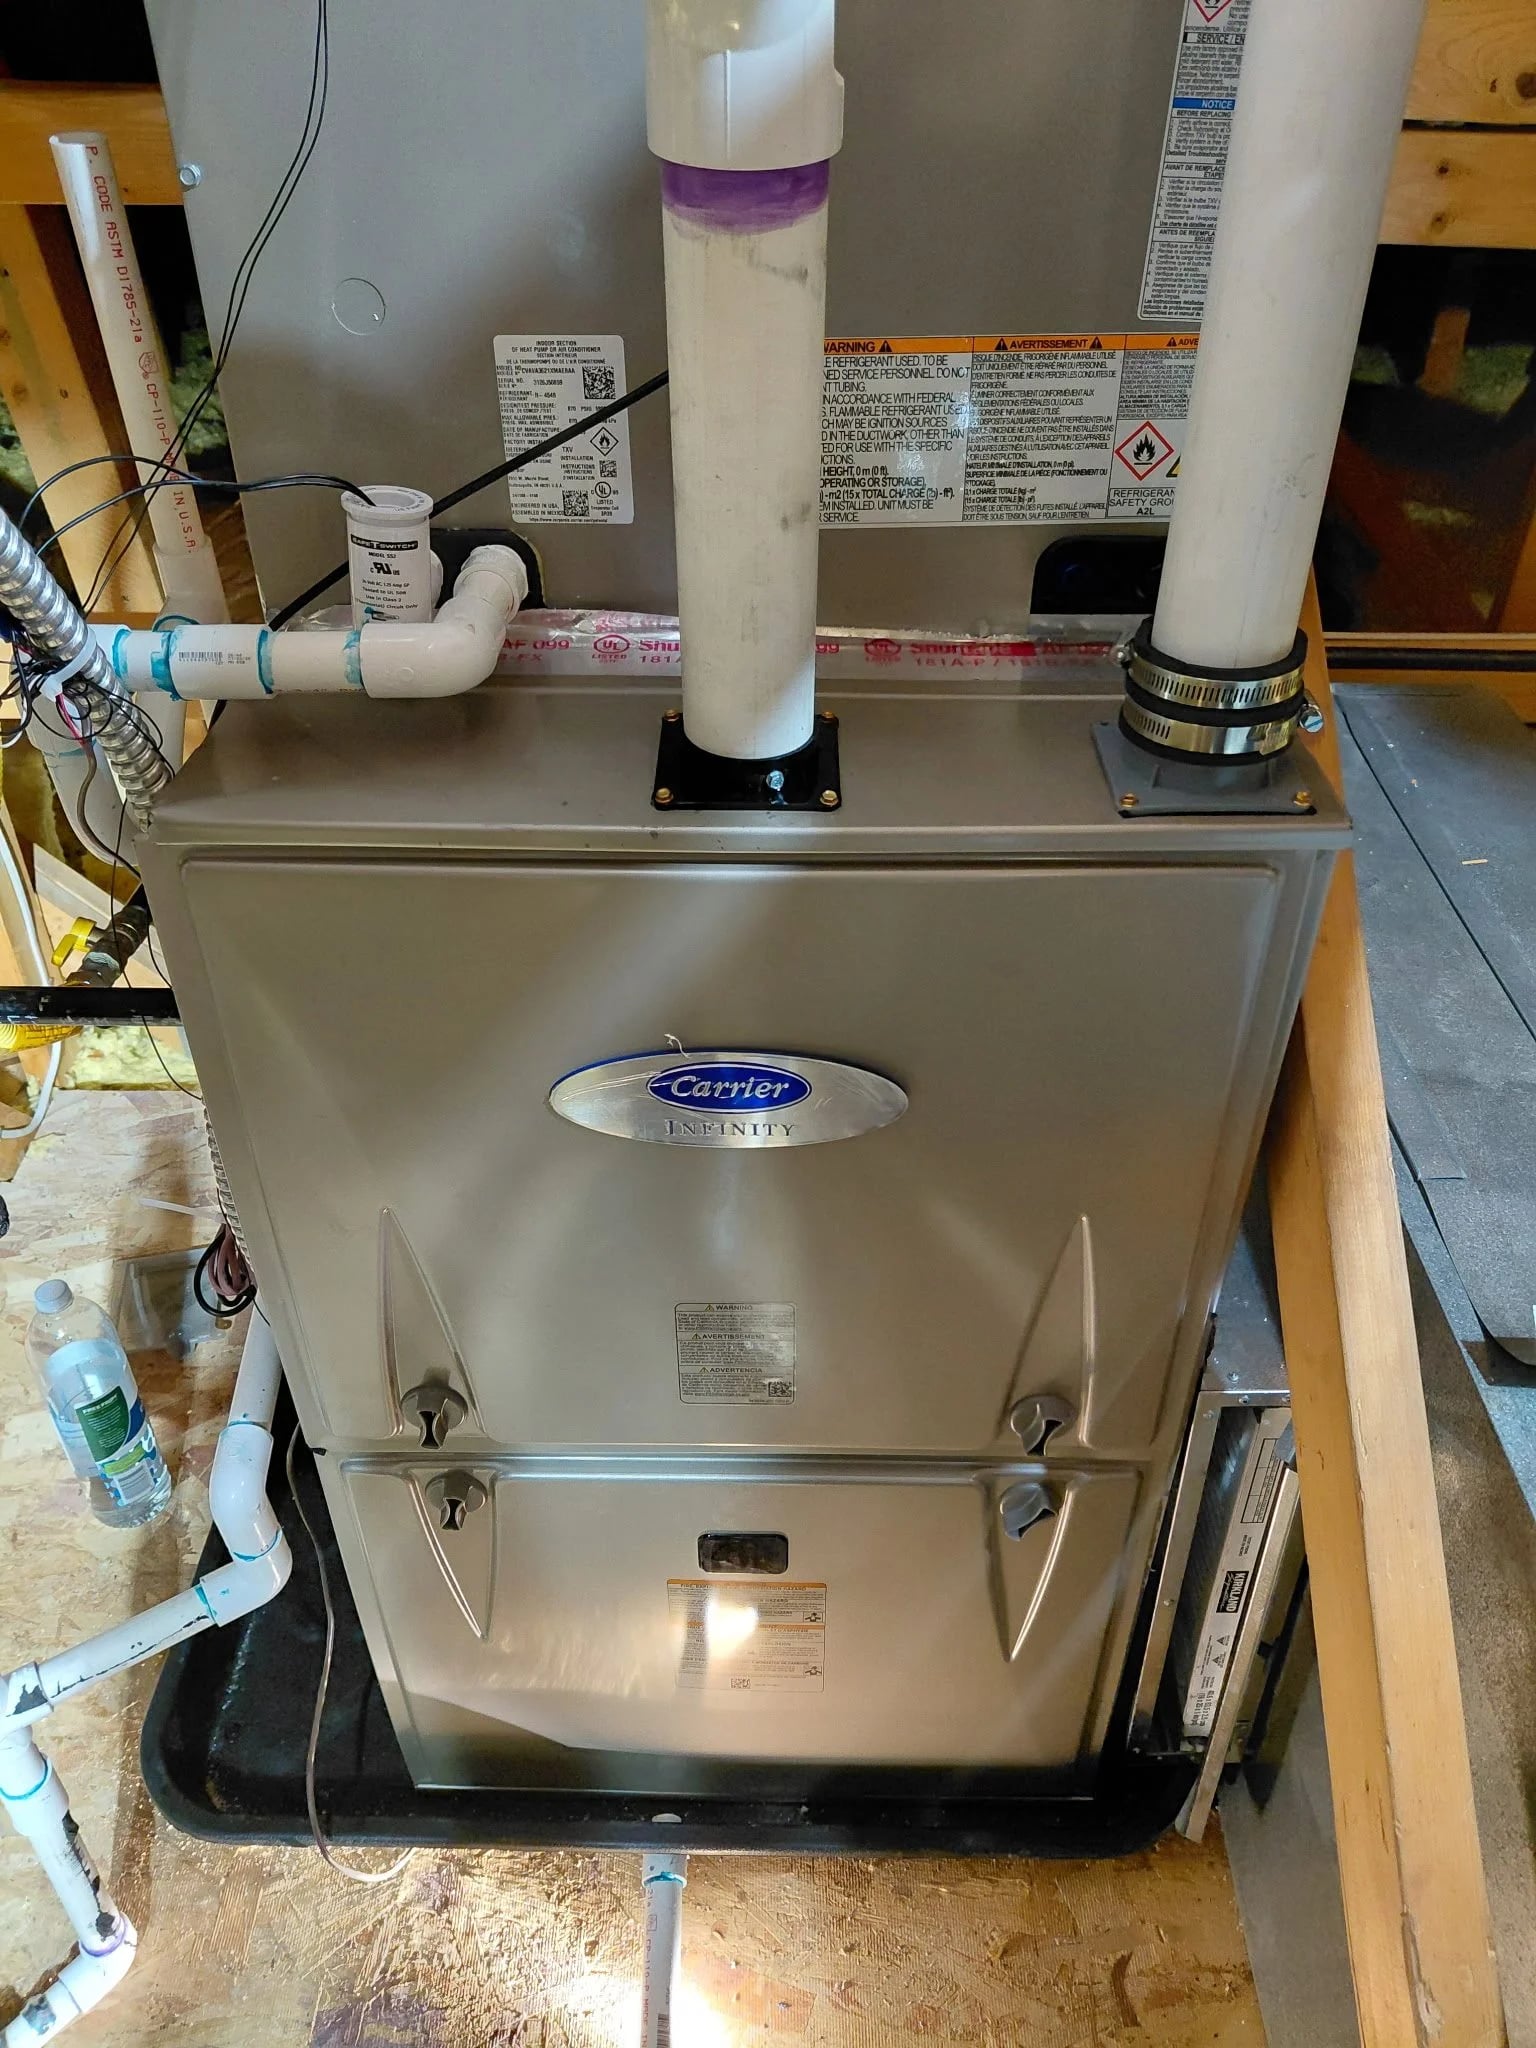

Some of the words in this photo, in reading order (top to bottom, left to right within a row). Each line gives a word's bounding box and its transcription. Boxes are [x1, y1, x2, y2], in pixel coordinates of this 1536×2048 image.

[1197, 33, 1229, 44] SERVICE
[1202, 100, 1233, 109] NOTICE
[94, 175, 113, 213] CODE
[105, 221, 124, 258] ASTM
[117, 266, 143, 343] D1785-21a
[1010, 339, 1089, 349] AVERTISSEMENT
[833, 356, 894, 367] REFRIGERANT
[924, 355, 936, 366] TO
[936, 355, 948, 366] BE
[842, 368, 879, 380] SERVICE
[937, 367, 950, 378] DO
[951, 366, 971, 378] NOT
[832, 393, 892, 404] ACCORDANCE
[893, 393, 916, 404] WITH
[917, 392, 956, 403] FEDERAL
[830, 406, 880, 417] FLAMMABLE
[882, 405, 942, 416] REFRIGERANT
[836, 419, 853, 429] MAY
[855, 418, 867, 429] BE
[868, 418, 904, 428] IGNITION
[905, 417, 948, 427] SOURCES
[829, 431, 839, 440] IN
[840, 430, 856, 440] THE
[910, 429, 940, 439] OTHER
[941, 429, 964, 439] THAN
[146, 383, 171, 445] CP-110-P
[173, 490, 185, 506] IN
[836, 442, 853, 453] FOR
[855, 442, 873, 452] USE
[874, 441, 895, 452] WITH
[896, 441, 911, 451] THE
[911, 441, 953, 451] SPECIFIC
[823, 466, 855, 477] HEIGHT,
[862, 467, 870, 476] m
[867, 478, 880, 488] OR
[861, 489, 888, 499] TOTAL
[889, 488, 926, 499] CHARGE
[1113, 489, 1175, 497] REFRIGERAN
[877, 500, 897, 510] UNIT
[898, 500, 920, 510] MUST
[922, 500, 933, 509] BE
[1109, 498, 1147, 506] SAFETY
[1136, 507, 1155, 515] A2L
[533, 639, 570, 650] 099
[670, 1075, 791, 1100] Carrier
[663, 1118, 798, 1138] INFINITY
[1226, 1573, 1246, 1611] KIRKLAND
